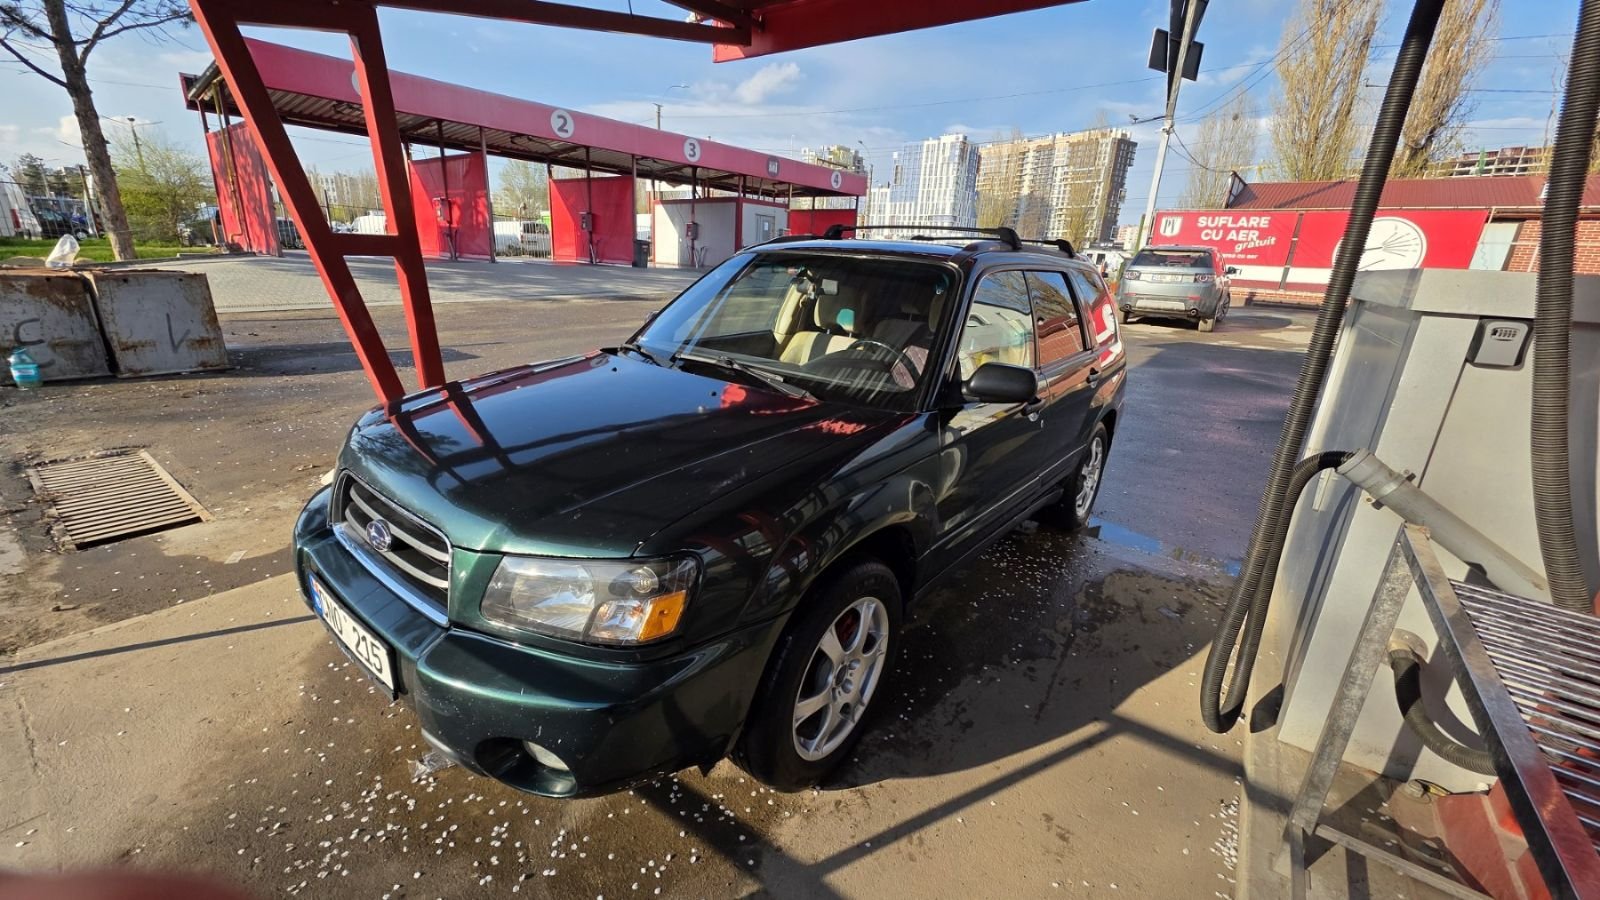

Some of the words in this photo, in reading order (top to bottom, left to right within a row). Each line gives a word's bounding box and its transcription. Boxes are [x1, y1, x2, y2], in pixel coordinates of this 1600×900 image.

[556, 115, 569, 133] 2
[688, 143, 696, 158] 3
[1197, 215, 1271, 228] SUFLARE
[1201, 229, 1223, 241] CU
[1226, 229, 1259, 241] AER
[1235, 236, 1276, 253] gratuit
[352, 625, 384, 675] 215
